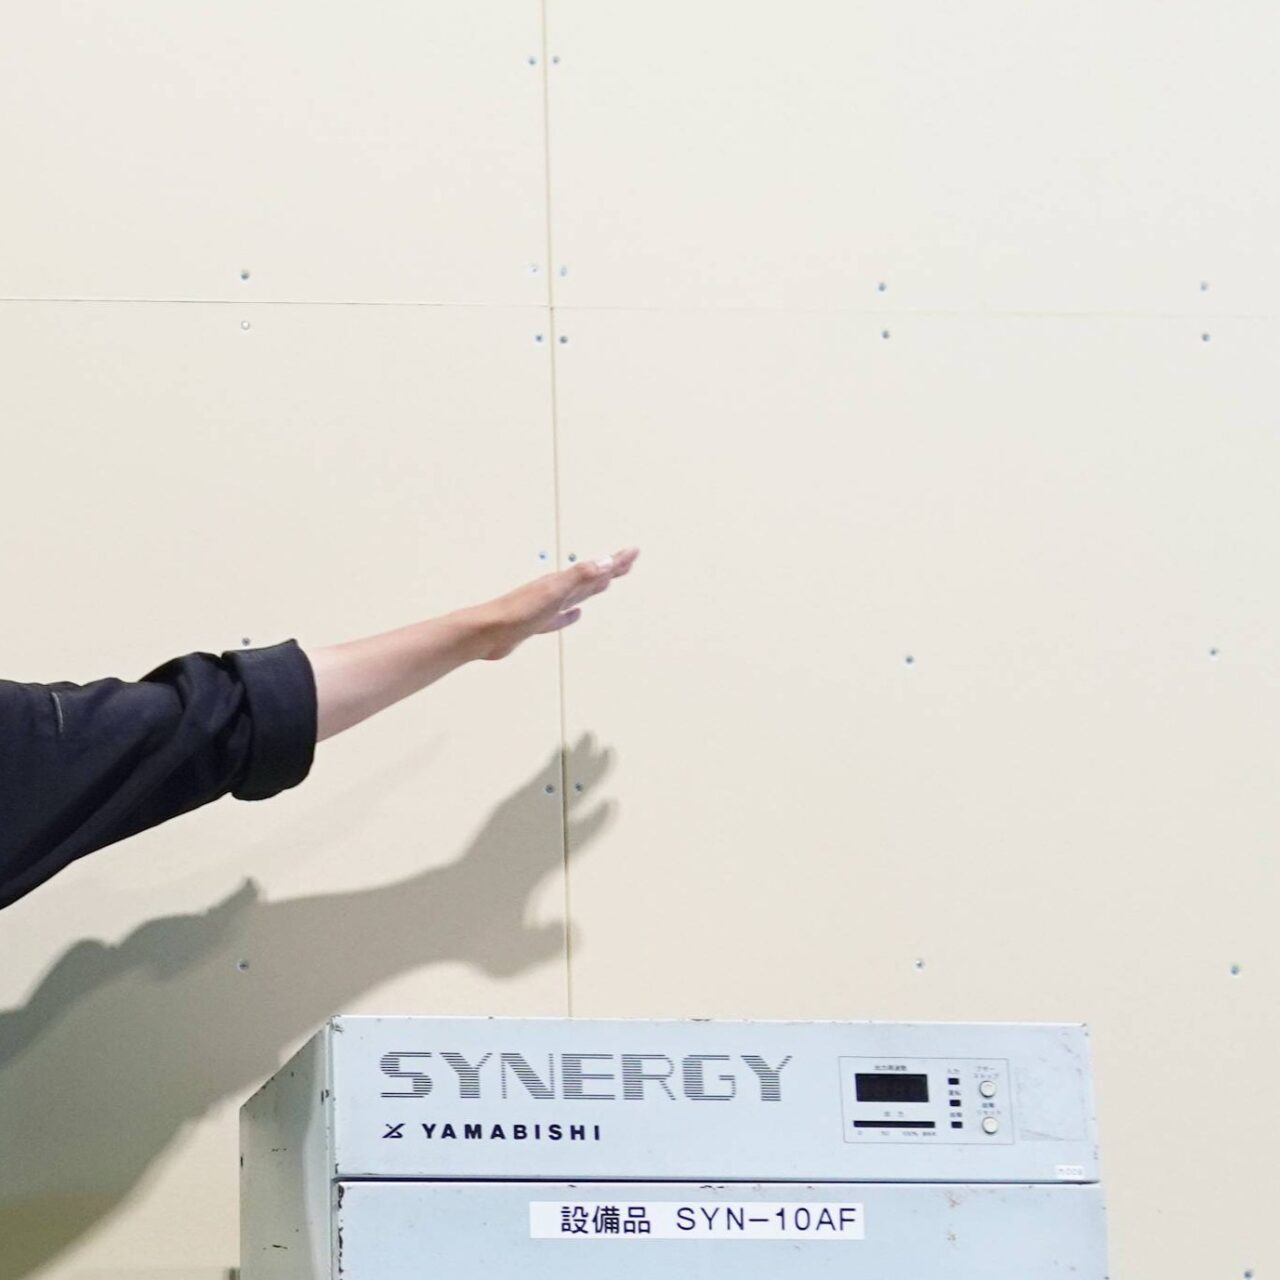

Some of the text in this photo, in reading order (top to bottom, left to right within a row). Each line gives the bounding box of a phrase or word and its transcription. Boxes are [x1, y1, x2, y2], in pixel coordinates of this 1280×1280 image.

[380, 1051, 793, 1102] SYNERGY
[421, 1123, 600, 1141] YAMABISHI
[560, 1205, 856, 1234] 設備品 SYN-10AF
